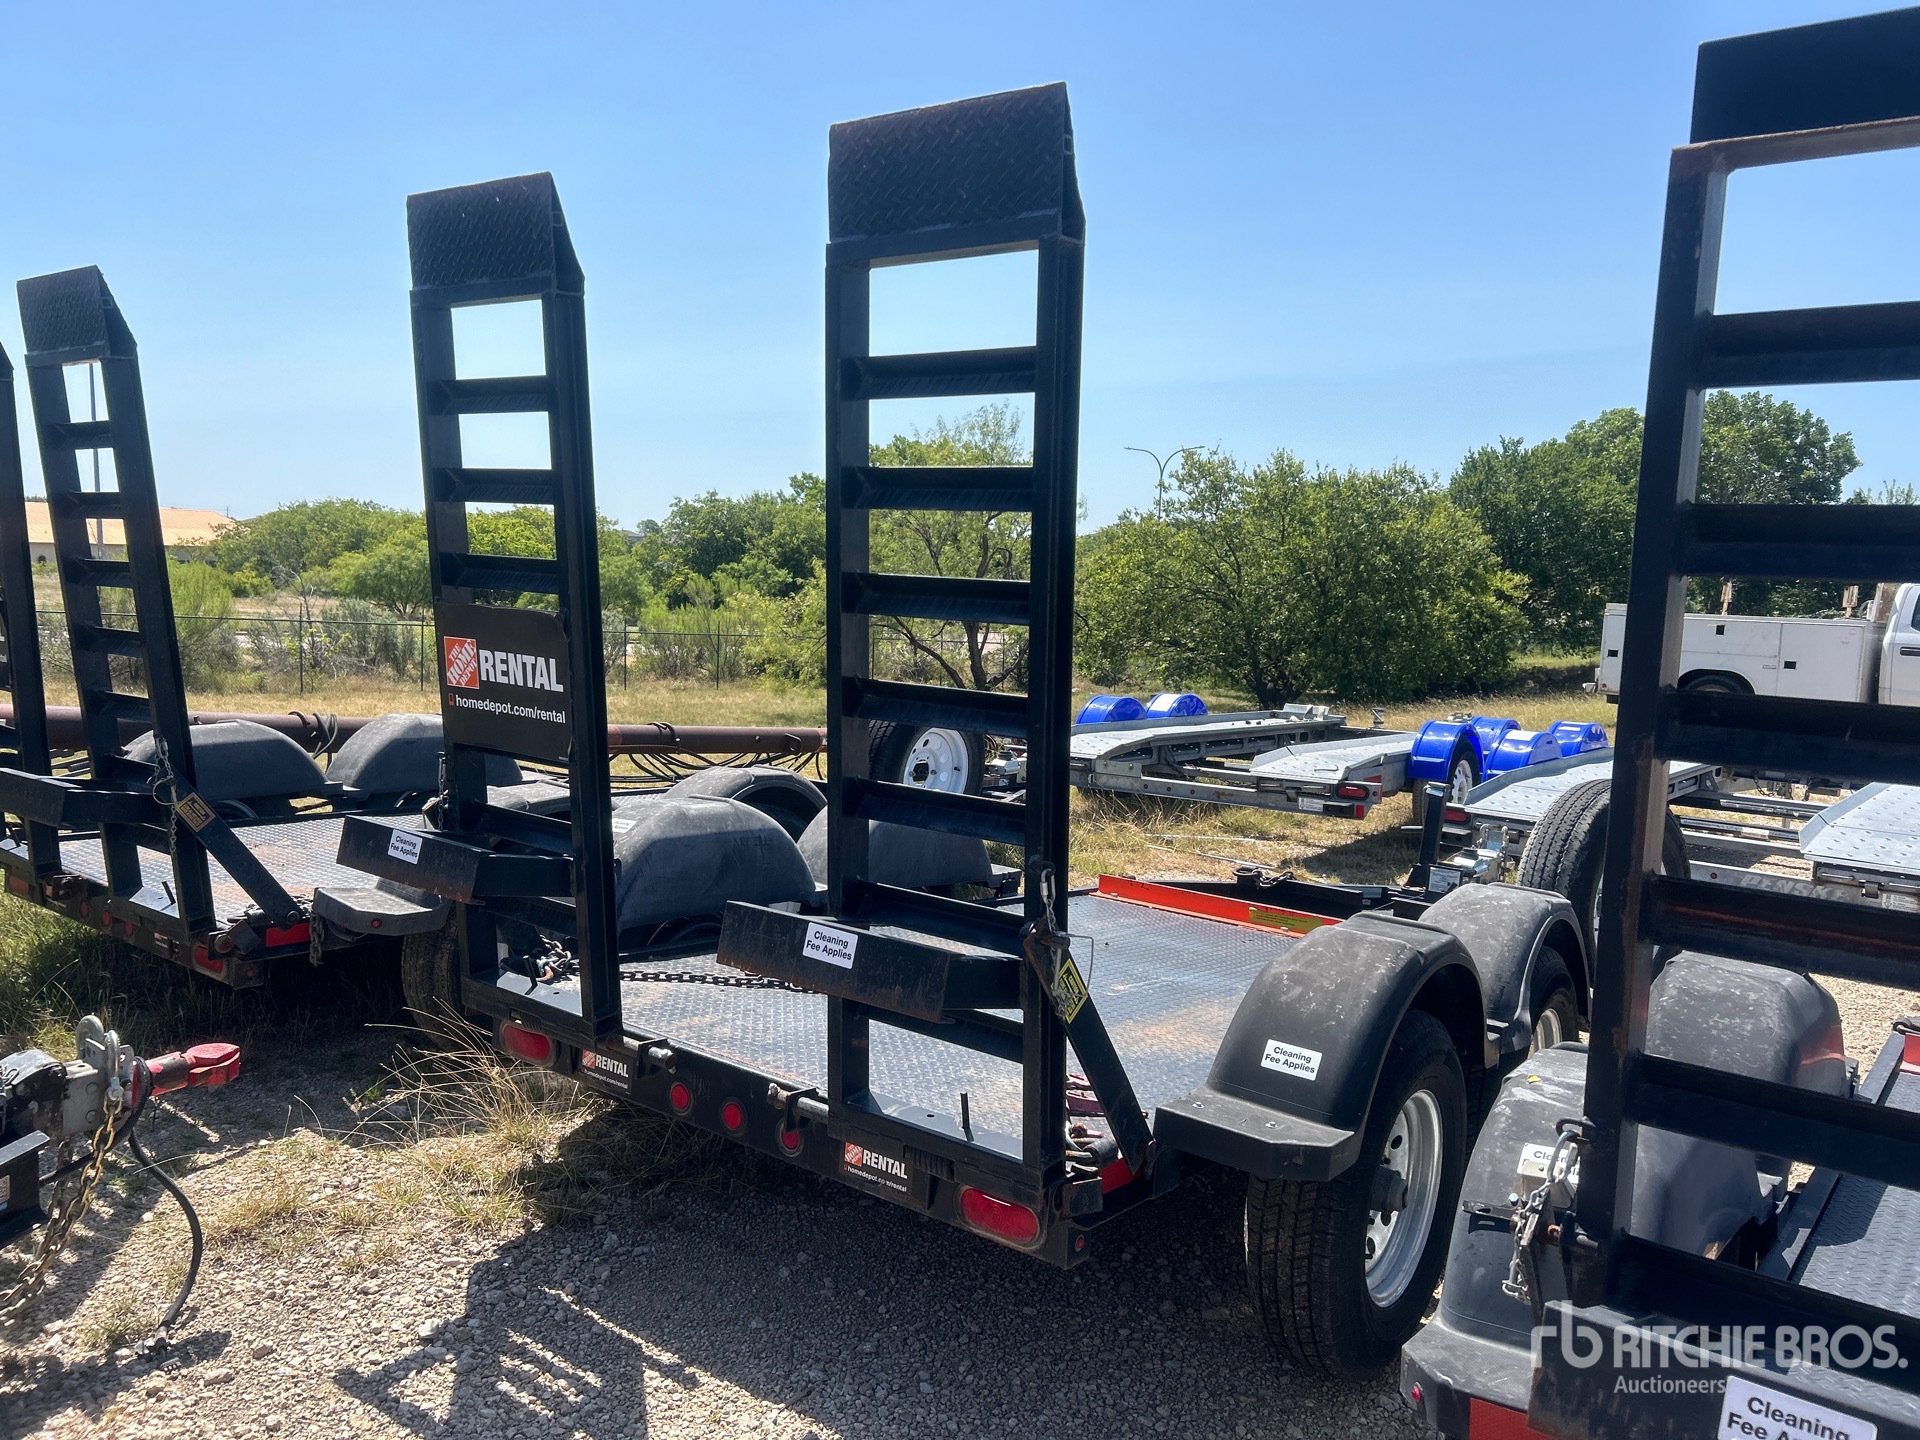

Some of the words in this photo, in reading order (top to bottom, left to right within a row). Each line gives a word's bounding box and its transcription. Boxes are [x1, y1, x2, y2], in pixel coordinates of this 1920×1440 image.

[447, 639, 477, 685] HOME
[449, 643, 461, 661] THE
[479, 649, 564, 692] RENTAL
[456, 694, 566, 723] homedepot.com/rental
[391, 842, 399, 852] Fee
[400, 846, 418, 858] Applies
[395, 835, 417, 850] Cleaning
[806, 939, 821, 952] Fee
[822, 944, 852, 960] Applies
[814, 930, 849, 949] Cleaning
[1265, 1053, 1281, 1064] Fee
[1282, 1058, 1316, 1073] Applies
[1273, 1046, 1312, 1064] Cleaning
[595, 1054, 629, 1078] RENTAL
[584, 1068, 629, 1089] homedepot.com/rental
[863, 1149, 908, 1179] RENTAL
[1727, 1411, 1768, 1440] Fee
[1747, 1396, 1850, 1440] Cleaning
